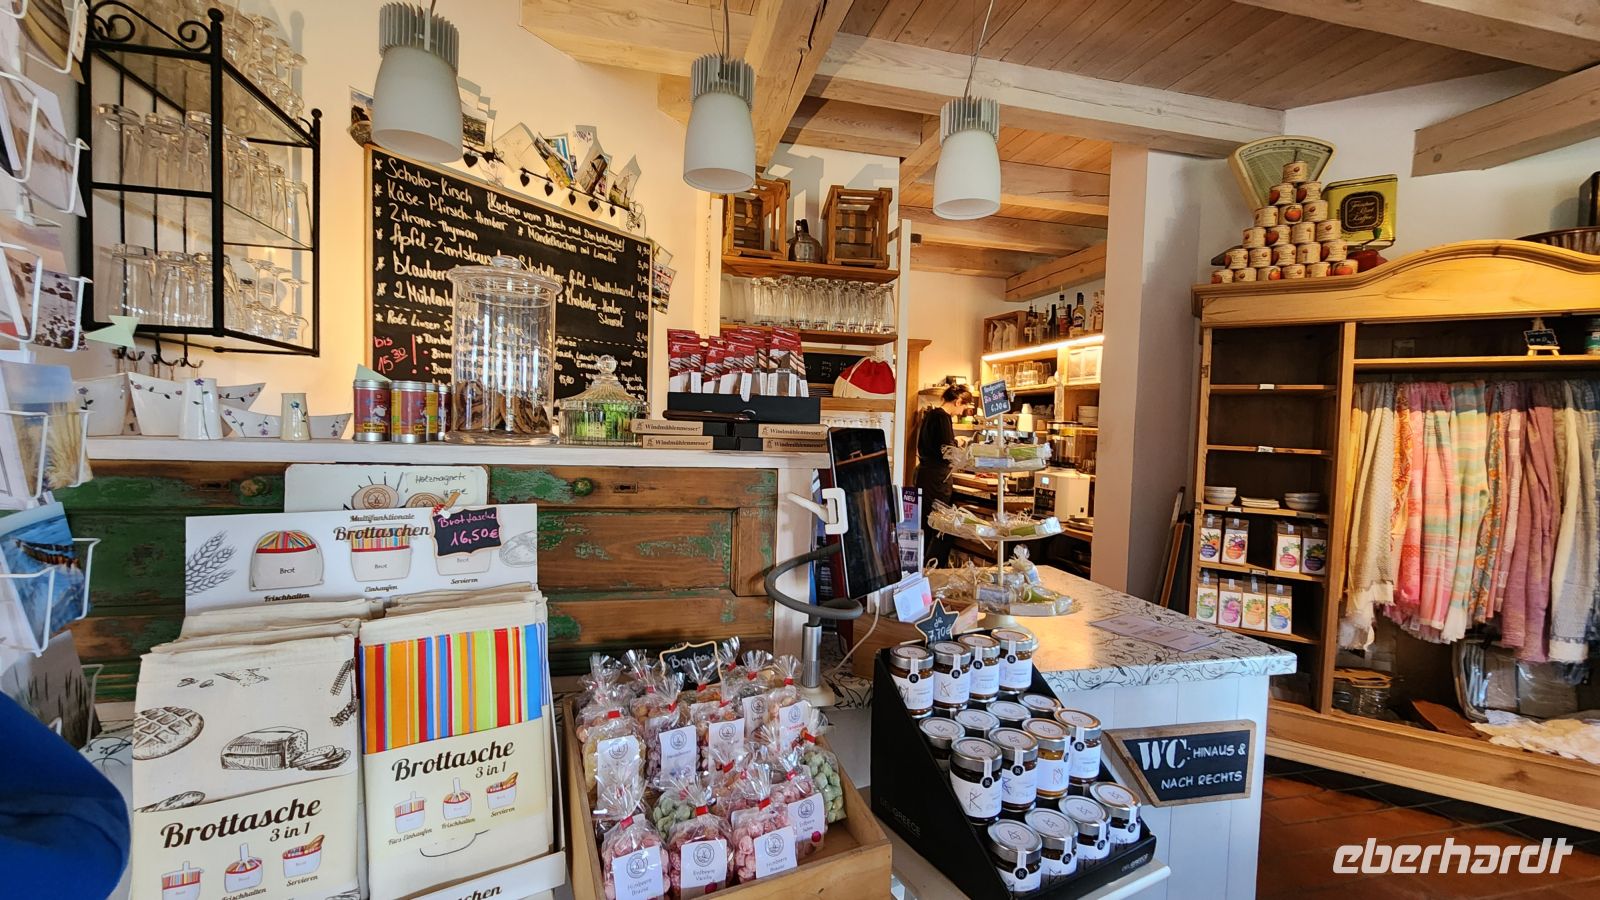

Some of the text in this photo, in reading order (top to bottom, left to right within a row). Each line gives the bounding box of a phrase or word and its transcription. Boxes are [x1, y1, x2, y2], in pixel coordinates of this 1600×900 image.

[350, 513, 415, 524] Multifunktionale
[438, 511, 497, 528] Brottasche
[333, 524, 431, 541] Brottaschen
[450, 528, 499, 546] 16,50€
[279, 567, 295, 575] Brot
[1193, 744, 1235, 759] HINAUS
[1237, 743, 1247, 755] &
[391, 741, 516, 781] Brottasche
[475, 766, 484, 779] 3
[487, 764, 499, 776] in
[1161, 771, 1243, 790] NACH RECHTS
[160, 798, 323, 848] Brottasche
[270, 829, 280, 842] 3
[284, 824, 300, 839] in
[286, 874, 318, 887] Servieren
